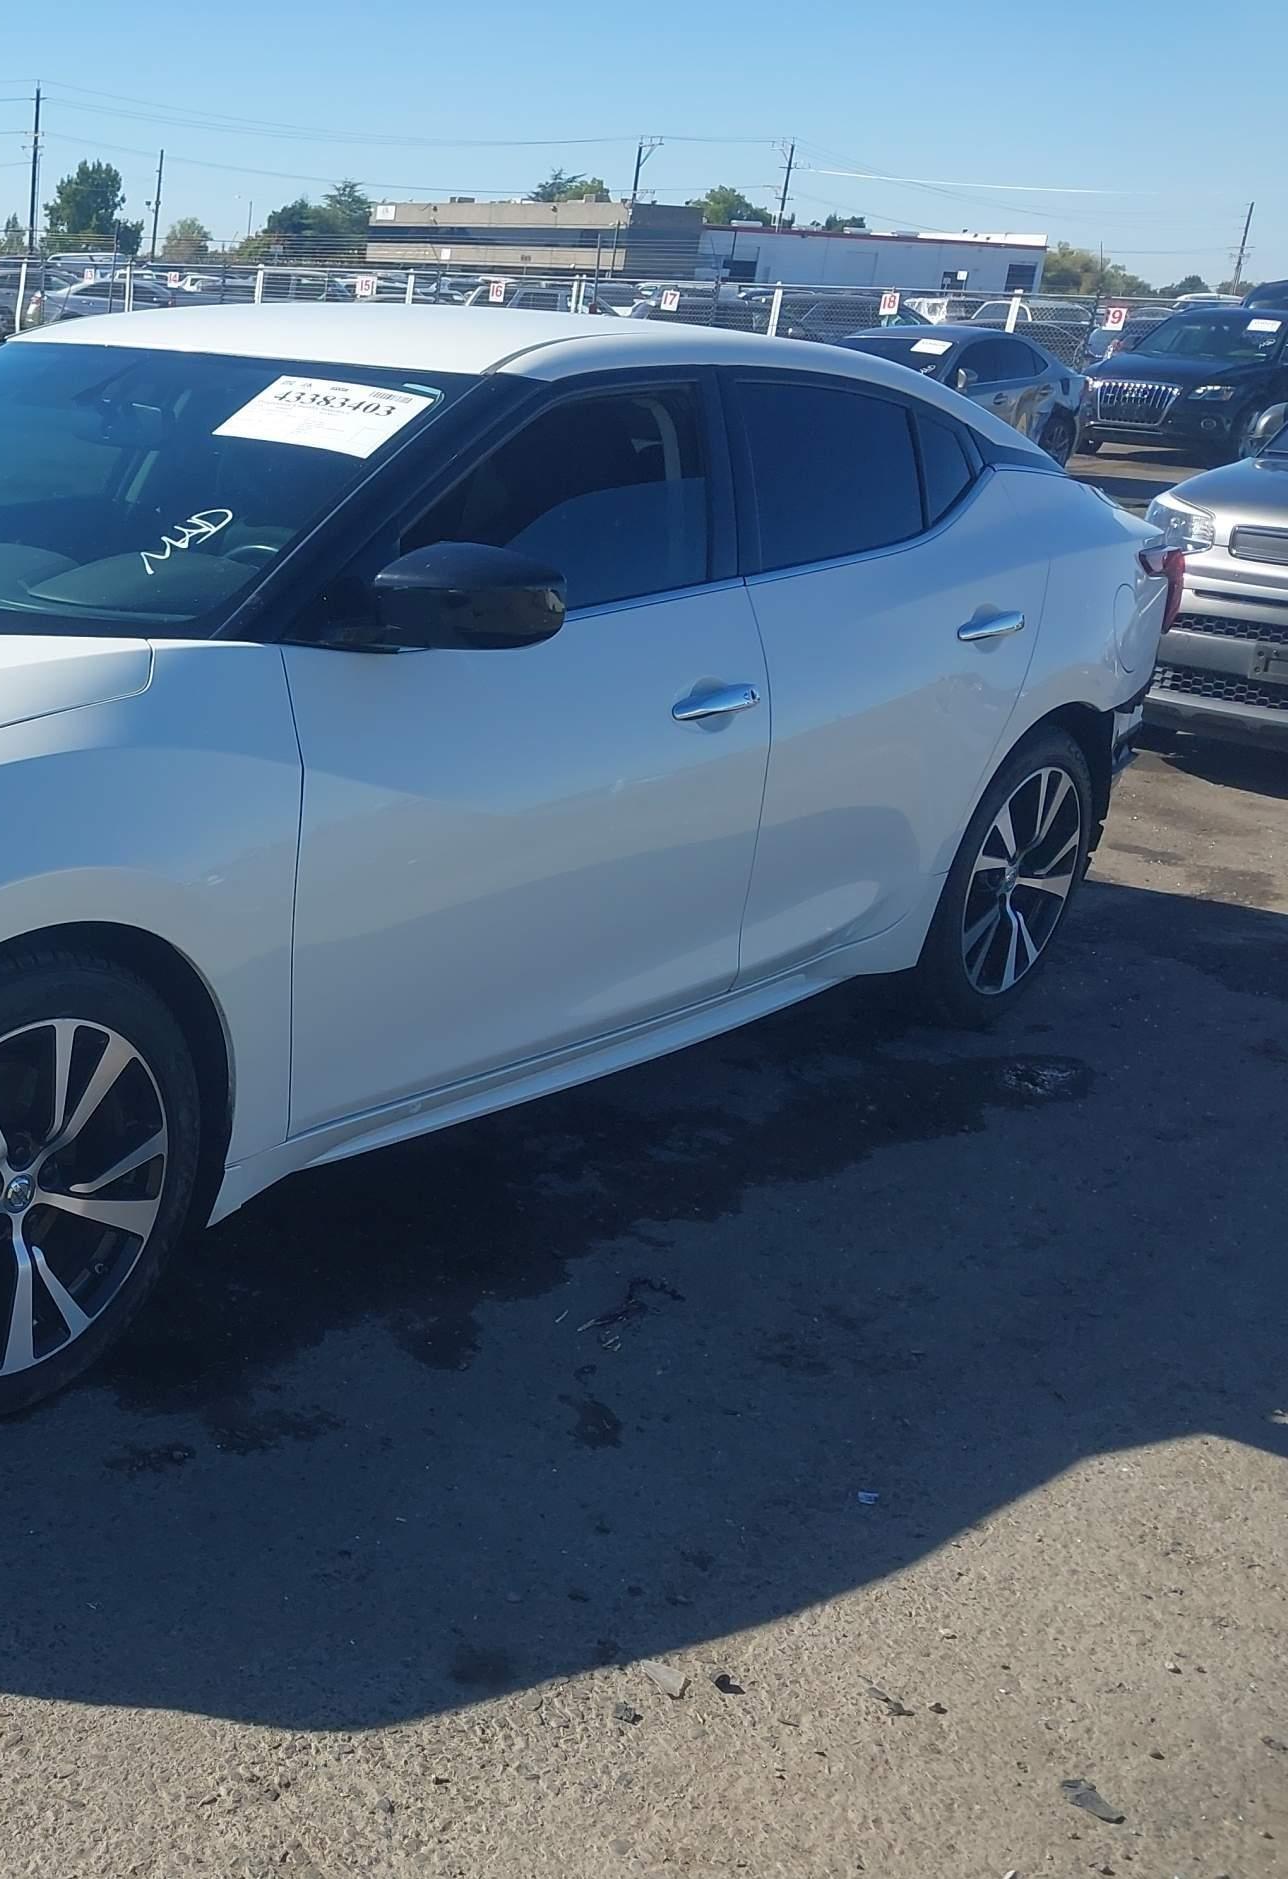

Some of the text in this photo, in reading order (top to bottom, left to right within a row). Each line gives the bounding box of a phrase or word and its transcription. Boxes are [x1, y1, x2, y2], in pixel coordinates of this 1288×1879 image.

[360, 279, 371, 292] 15
[491, 284, 503, 298] 16
[663, 291, 678, 306] 17
[882, 295, 897, 310] 18
[273, 390, 397, 417] 43383403
